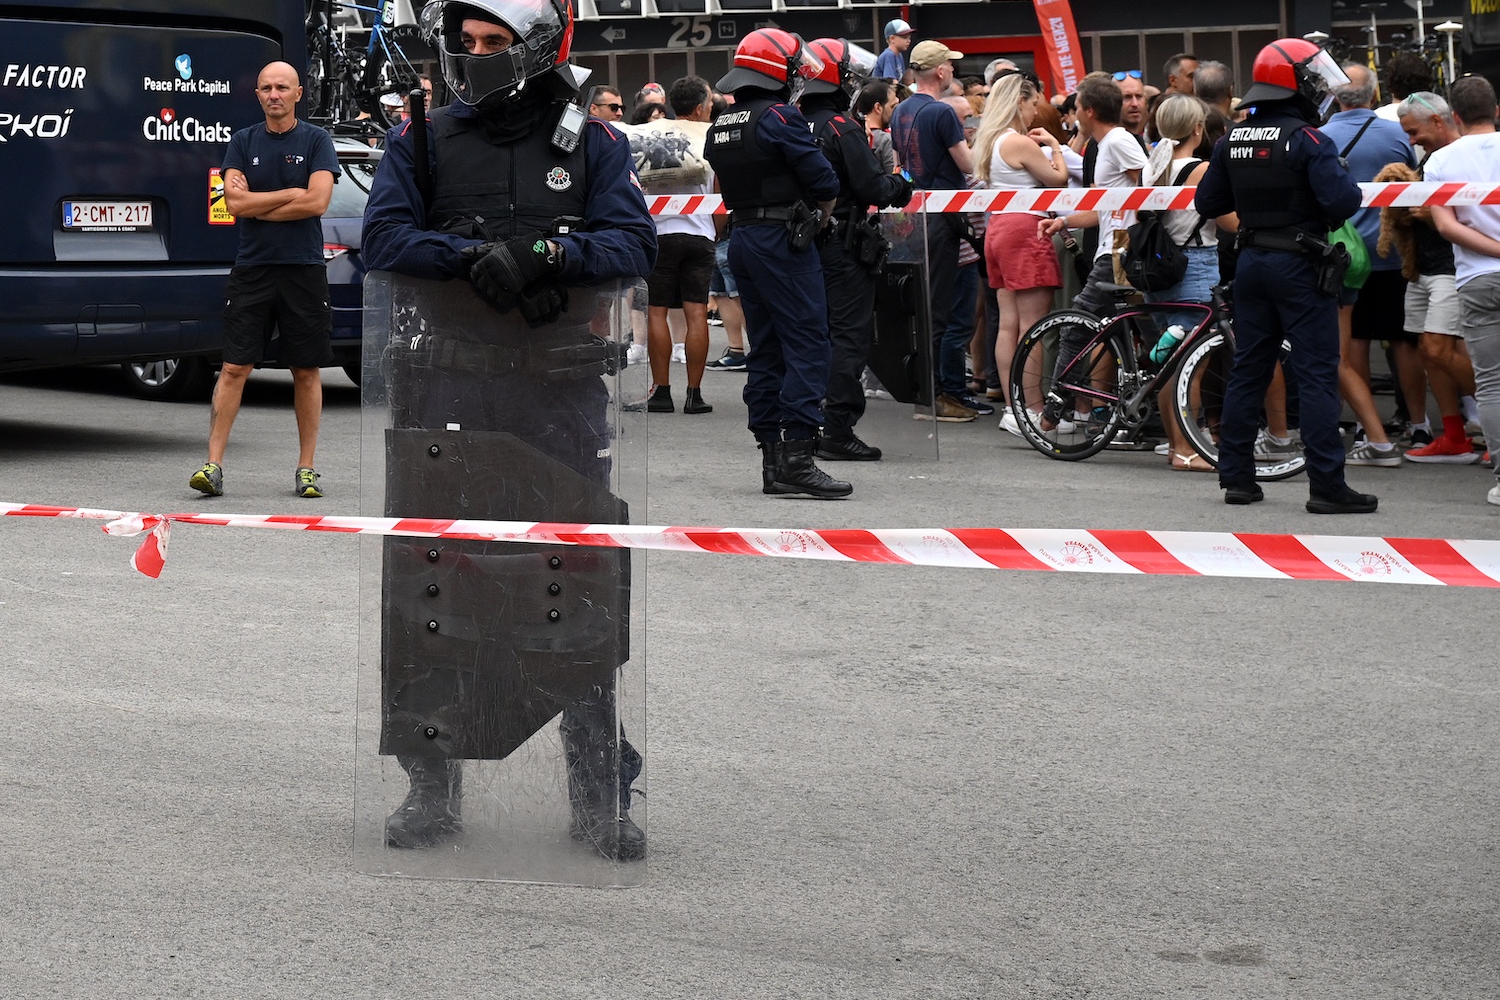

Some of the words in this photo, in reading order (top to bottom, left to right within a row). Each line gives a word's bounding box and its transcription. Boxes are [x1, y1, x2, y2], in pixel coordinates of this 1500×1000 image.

[614, 28, 623, 37] 26
[667, 16, 713, 48] 25
[3, 63, 87, 89] FACTOR
[144, 77, 172, 92] Peace
[174, 78, 197, 92] Park
[198, 79, 230, 97] Capital
[143, 115, 180, 141] Chit
[182, 117, 232, 143] Chats
[1228, 127, 1281, 141] ERTZAINTZA
[65, 216, 71, 224] B
[1030, 315, 1095, 339] COSMIC
